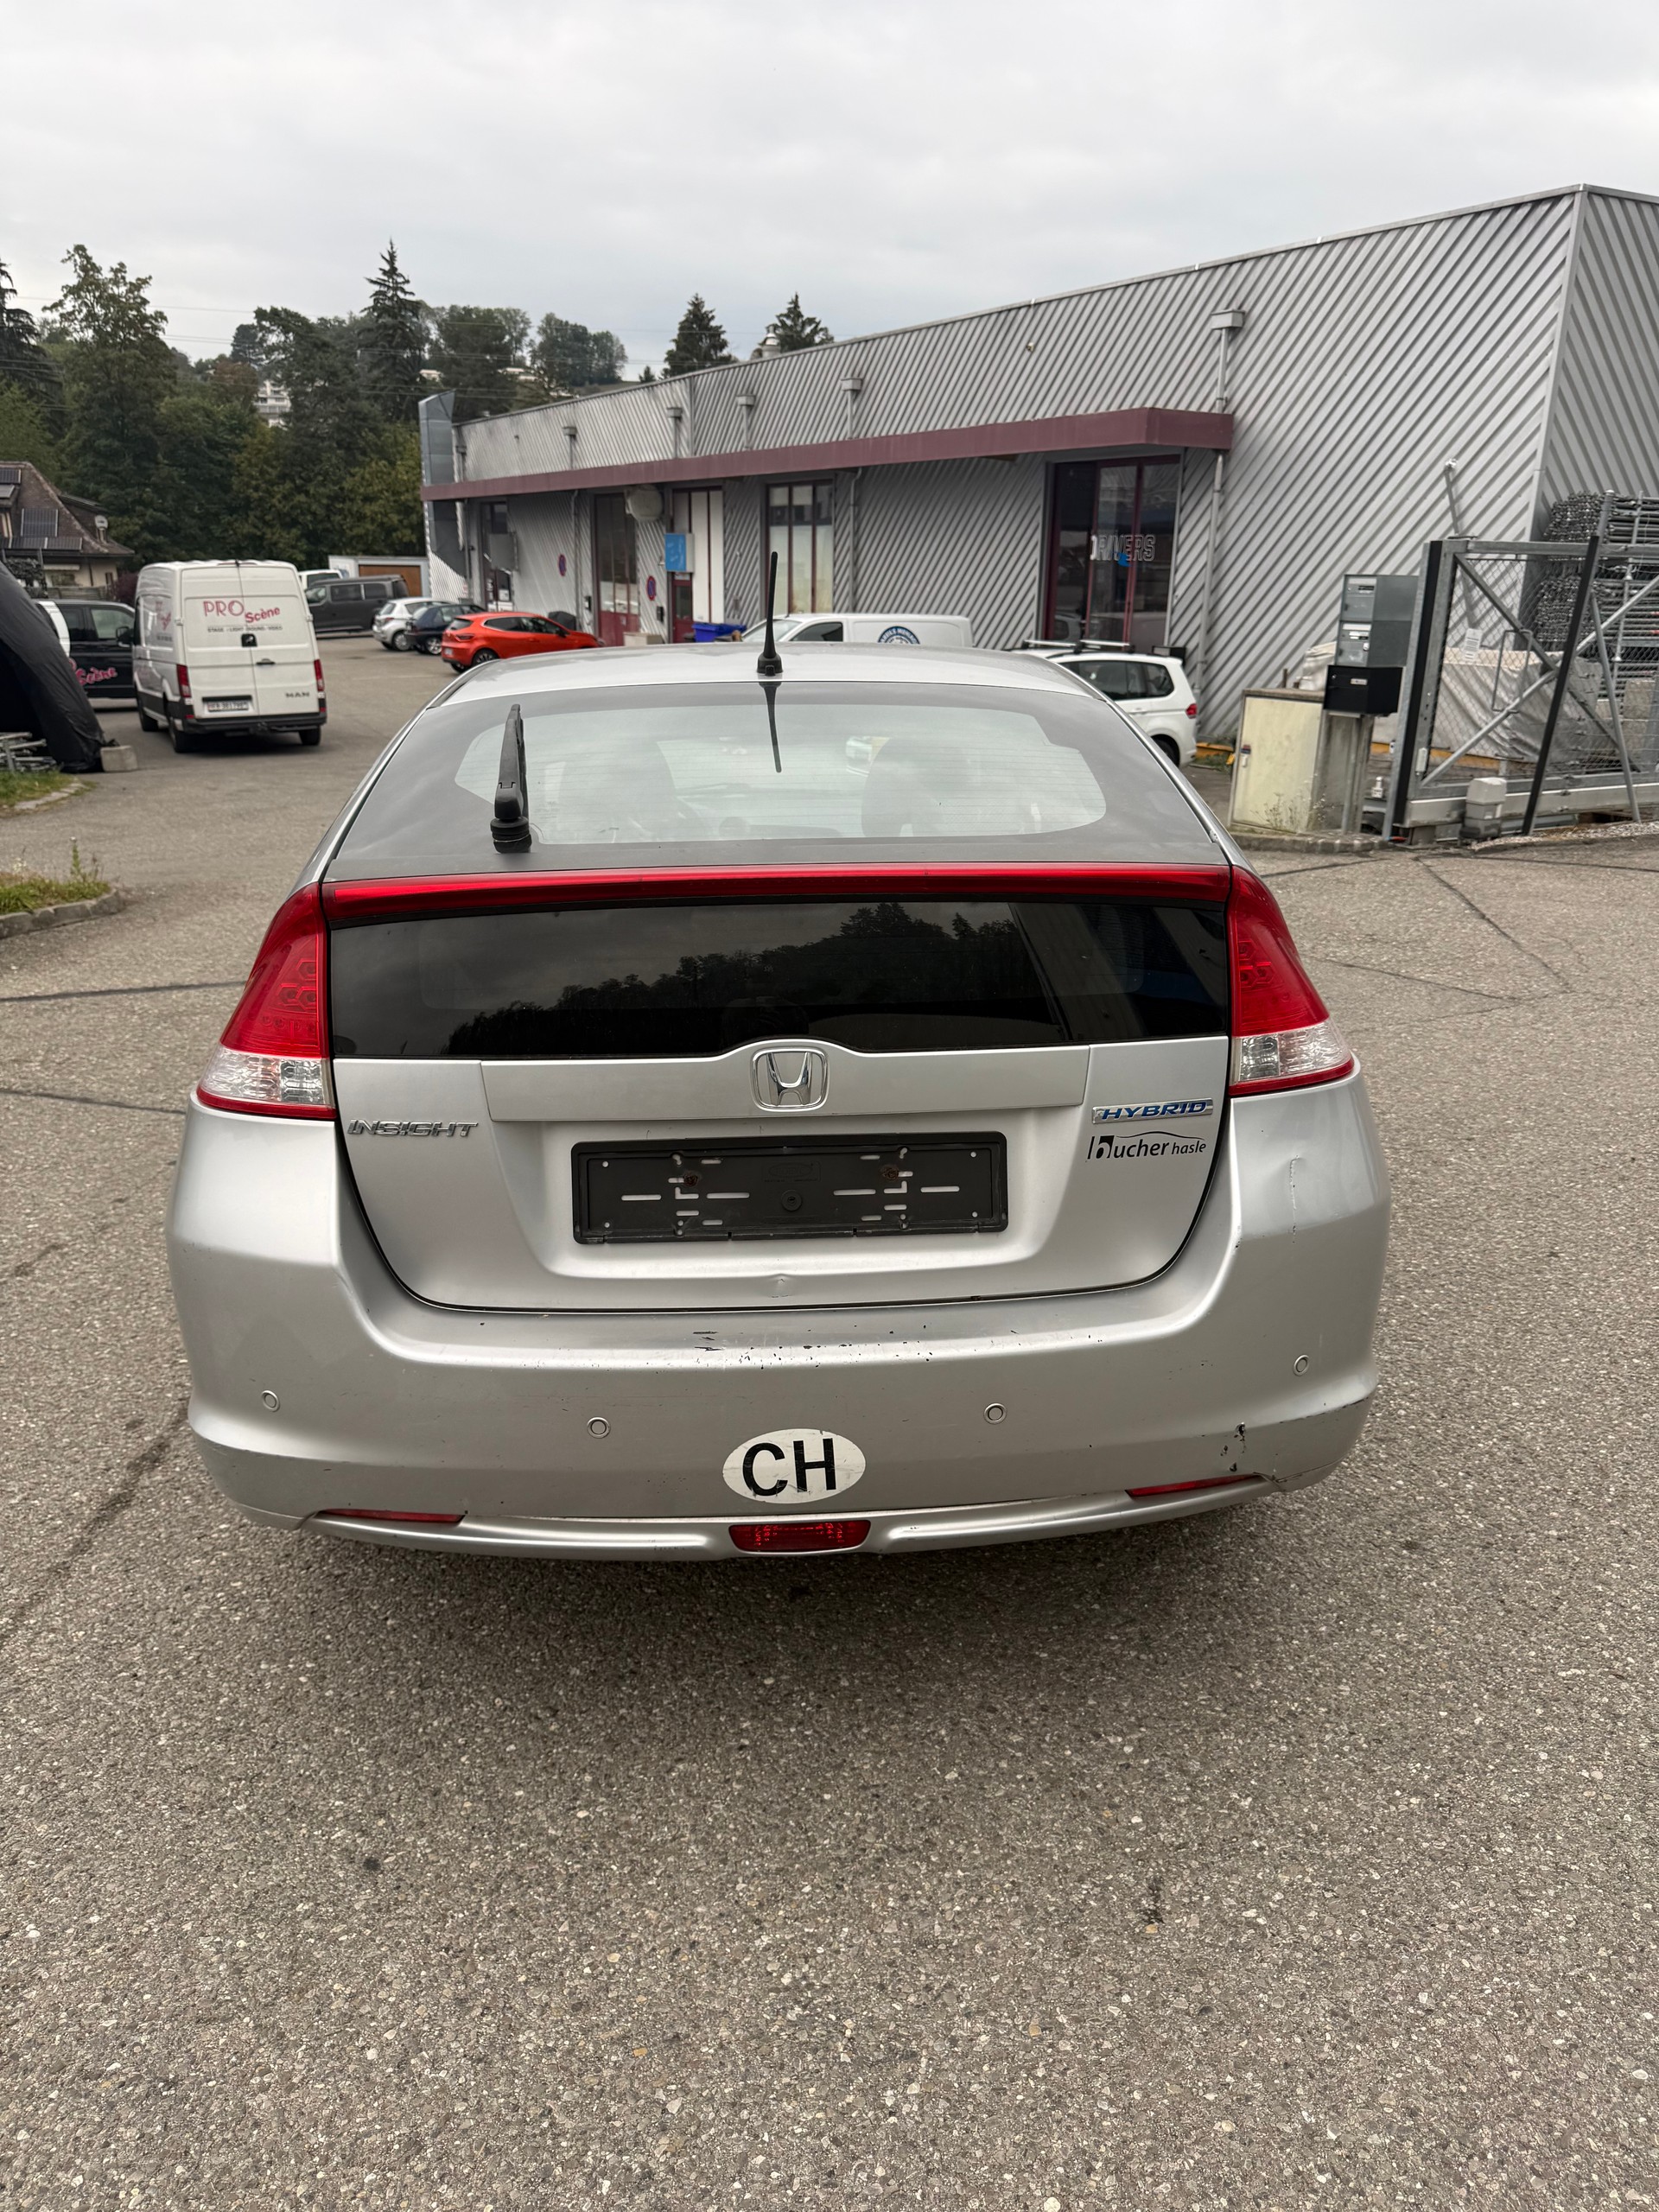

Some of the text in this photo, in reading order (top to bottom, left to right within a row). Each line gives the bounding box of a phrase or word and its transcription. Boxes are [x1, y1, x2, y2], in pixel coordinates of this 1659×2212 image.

[203, 600, 245, 617] PRO
[245, 607, 281, 623] Scène
[1102, 1101, 1207, 1120] HYBRID
[347, 1119, 479, 1137] INSIGHT
[1172, 1141, 1206, 1154] hasle
[742, 1437, 837, 1497] CH
